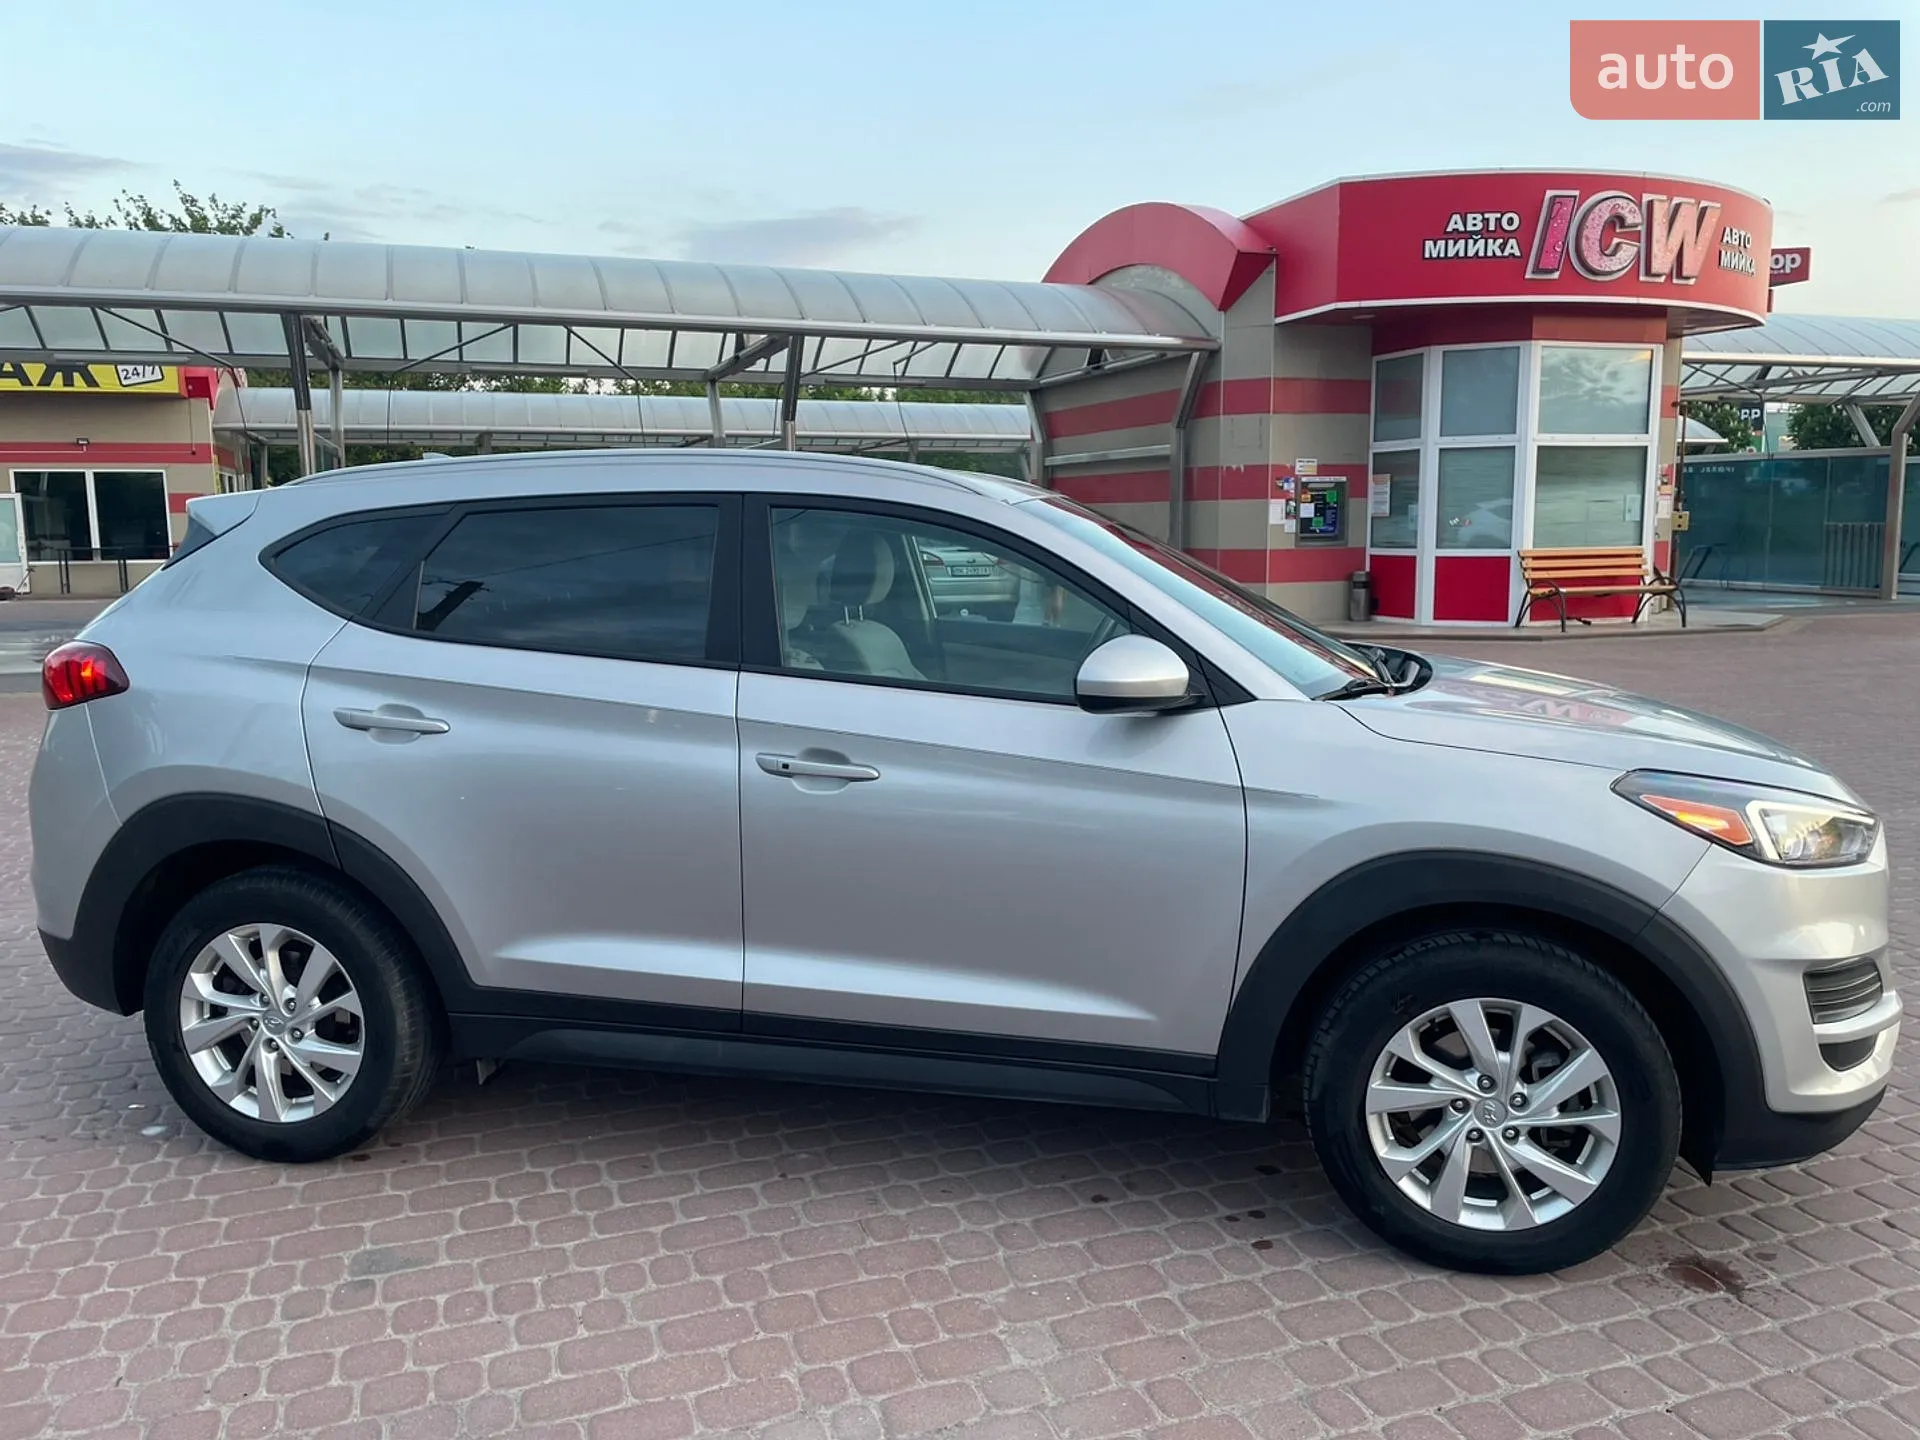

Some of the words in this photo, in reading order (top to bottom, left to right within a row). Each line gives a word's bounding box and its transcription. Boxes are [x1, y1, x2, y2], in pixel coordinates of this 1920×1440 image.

[1445, 211, 1520, 232] АВТО
[1424, 234, 1521, 259] МИЙКА
[1524, 189, 1721, 285] ICW
[1722, 227, 1752, 248] АВТО
[1720, 249, 1755, 273] МИЙКА
